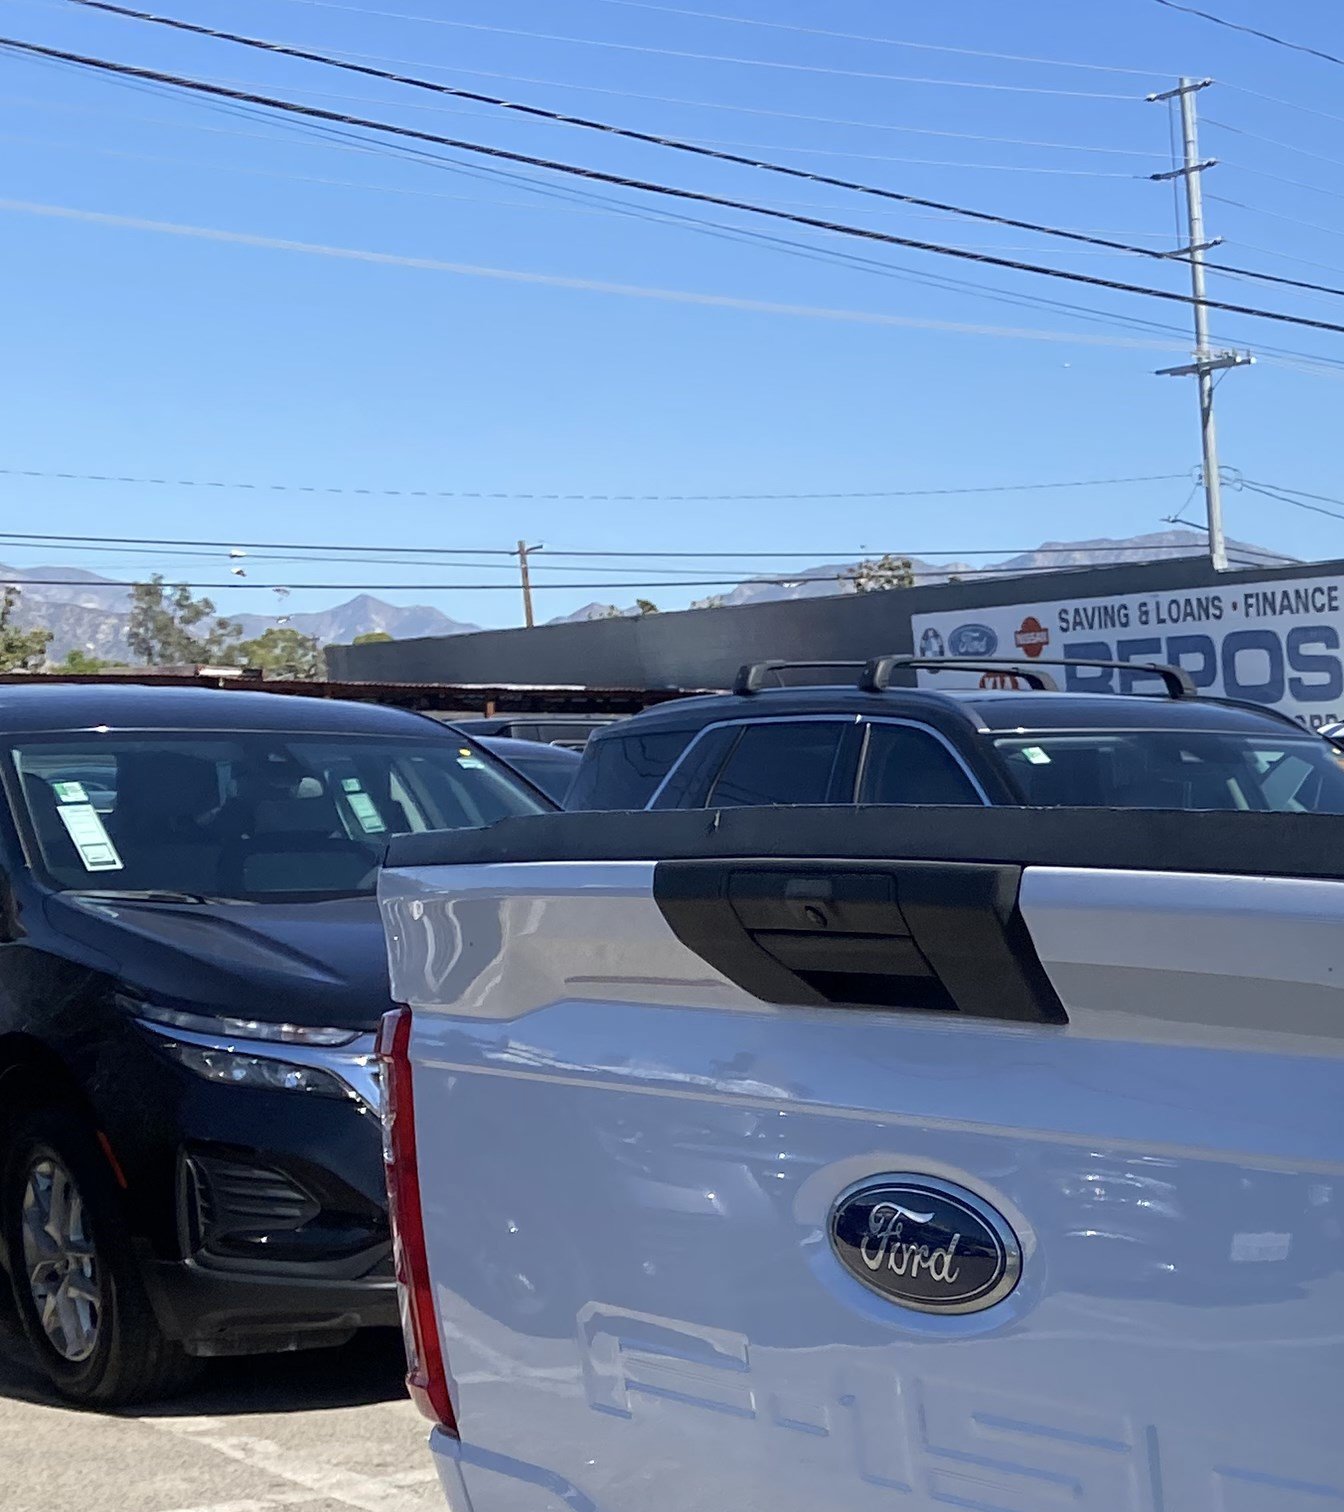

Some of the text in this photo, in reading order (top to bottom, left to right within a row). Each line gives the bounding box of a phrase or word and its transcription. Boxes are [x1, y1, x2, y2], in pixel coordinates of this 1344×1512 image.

[1058, 603, 1130, 633] SAVING
[1138, 602, 1149, 625] &
[1155, 596, 1223, 625] LOANS
[1243, 586, 1339, 619] FINANCE
[861, 1201, 961, 1284] Ford
